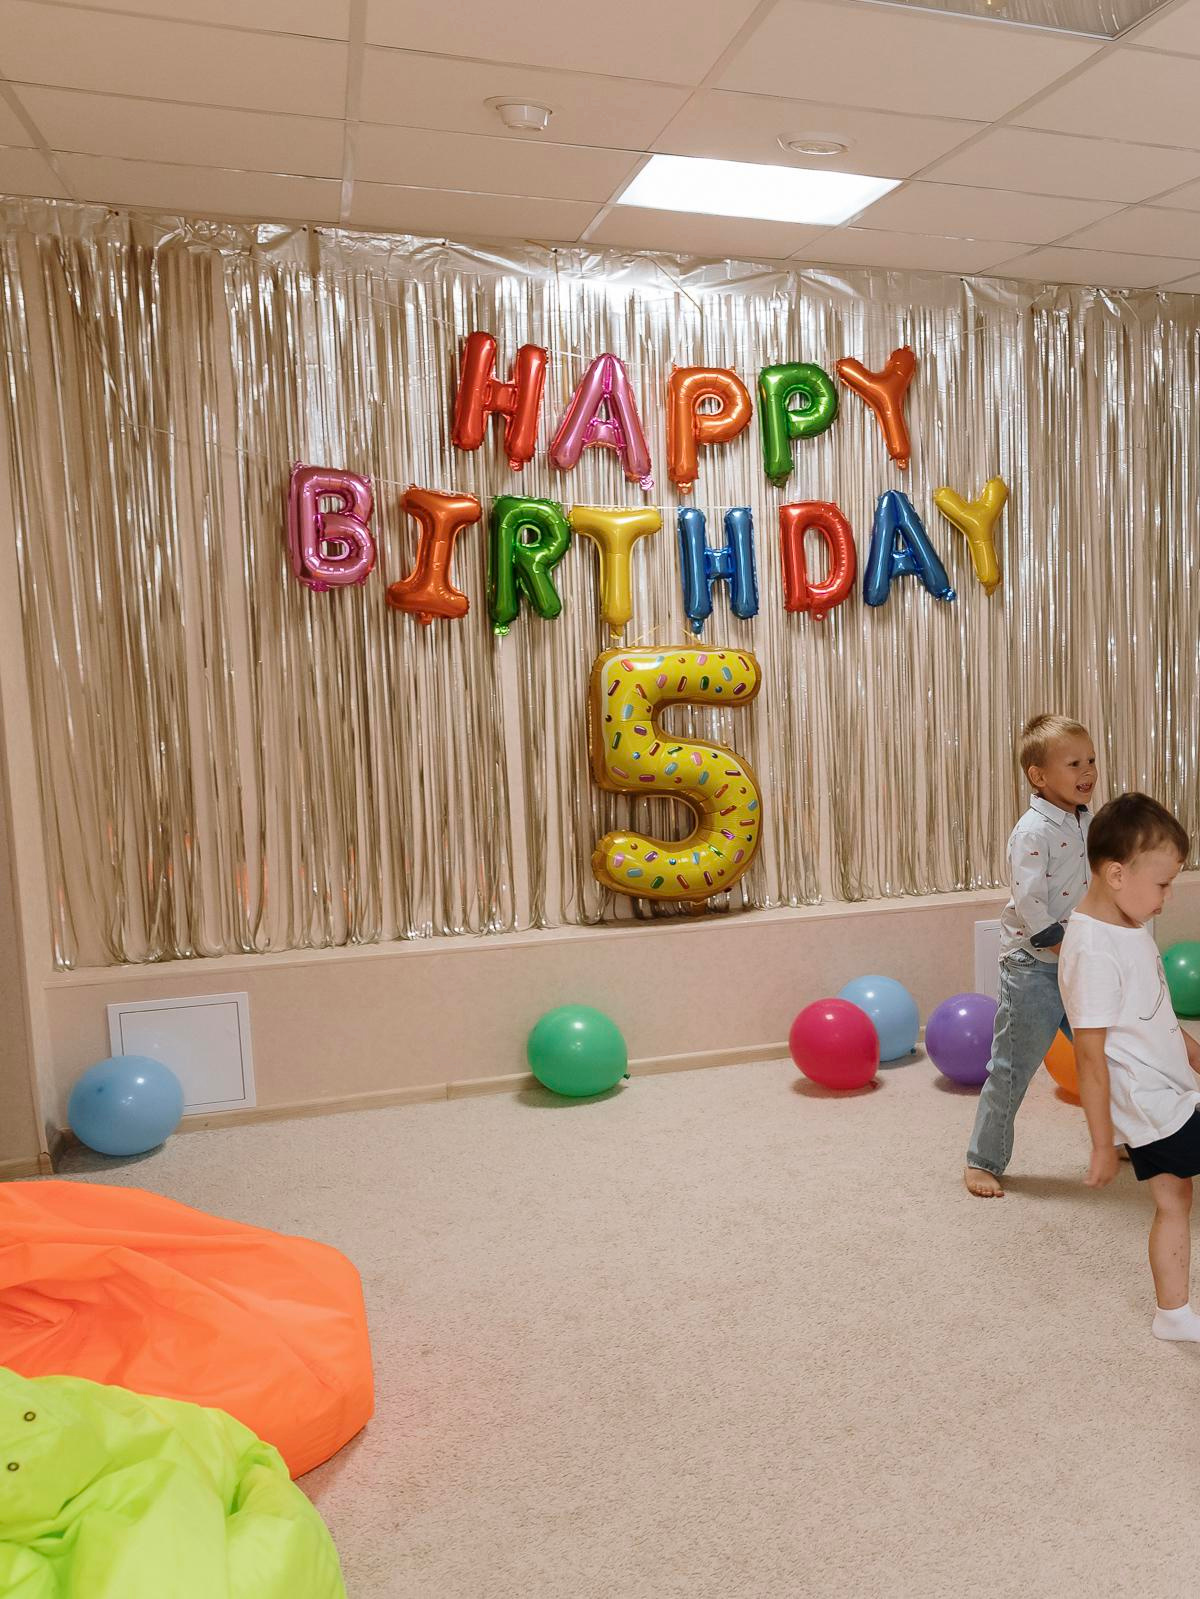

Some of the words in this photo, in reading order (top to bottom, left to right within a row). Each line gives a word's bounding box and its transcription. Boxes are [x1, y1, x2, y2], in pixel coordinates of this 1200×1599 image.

[451, 331, 918, 494] HAPPY
[287, 461, 1010, 637] BIRTHDAY
[589, 644, 763, 902] 5
